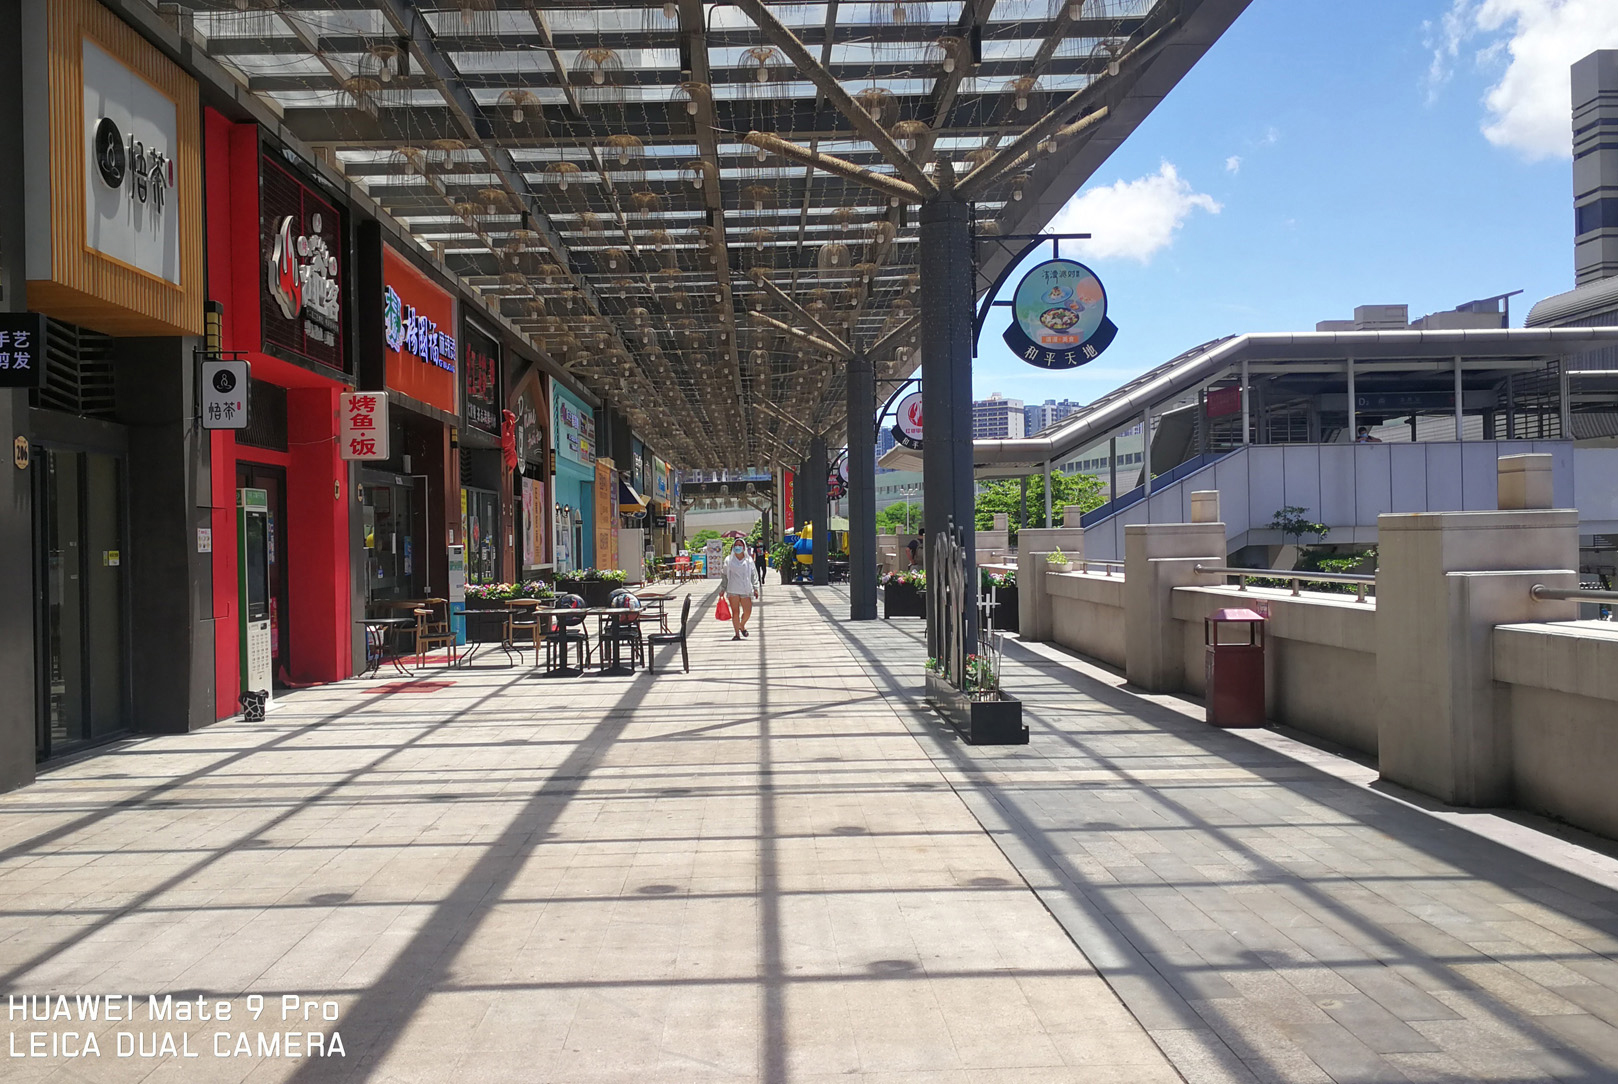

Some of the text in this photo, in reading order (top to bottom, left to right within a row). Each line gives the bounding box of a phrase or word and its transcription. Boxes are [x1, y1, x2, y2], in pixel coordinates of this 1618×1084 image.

[1024, 344, 1098, 366] 和平天地
[208, 402, 235, 421] 悟茶
[16, 445, 28, 461] 206
